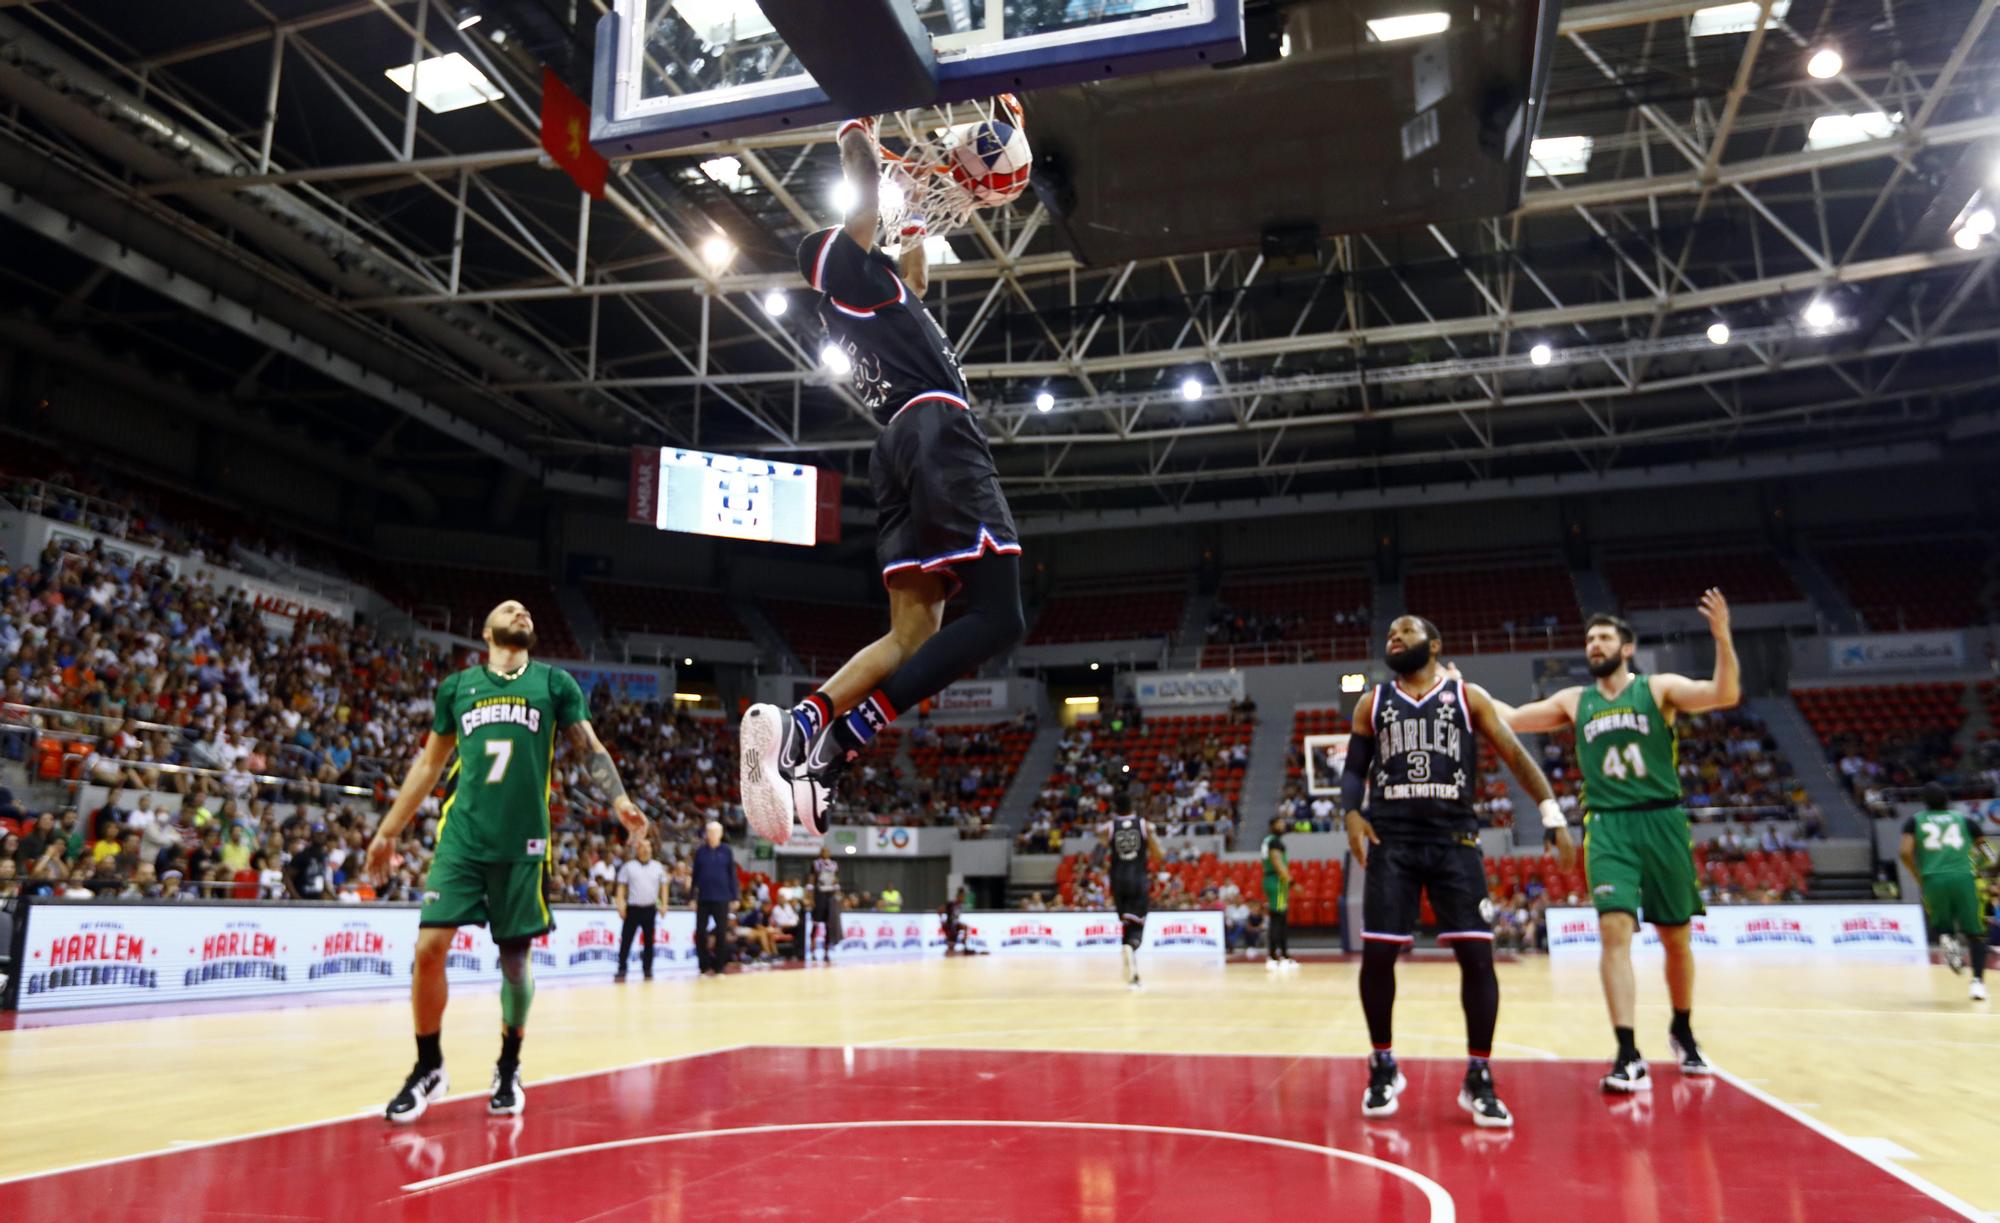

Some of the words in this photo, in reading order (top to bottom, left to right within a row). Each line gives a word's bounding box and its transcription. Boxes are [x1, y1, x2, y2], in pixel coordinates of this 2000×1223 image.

[461, 705, 541, 737] GENERALS
[1583, 712, 1649, 743] GENERALS
[1379, 718, 1461, 765] HARLEM
[485, 739, 513, 783] 7
[1407, 751, 1431, 783] 3
[1921, 822, 1965, 851] 24
[49, 933, 145, 967] HARLEM
[202, 932, 277, 961] HARLEM
[323, 931, 384, 957] HARLEM
[27, 964, 157, 995] GLOBETROTTERS
